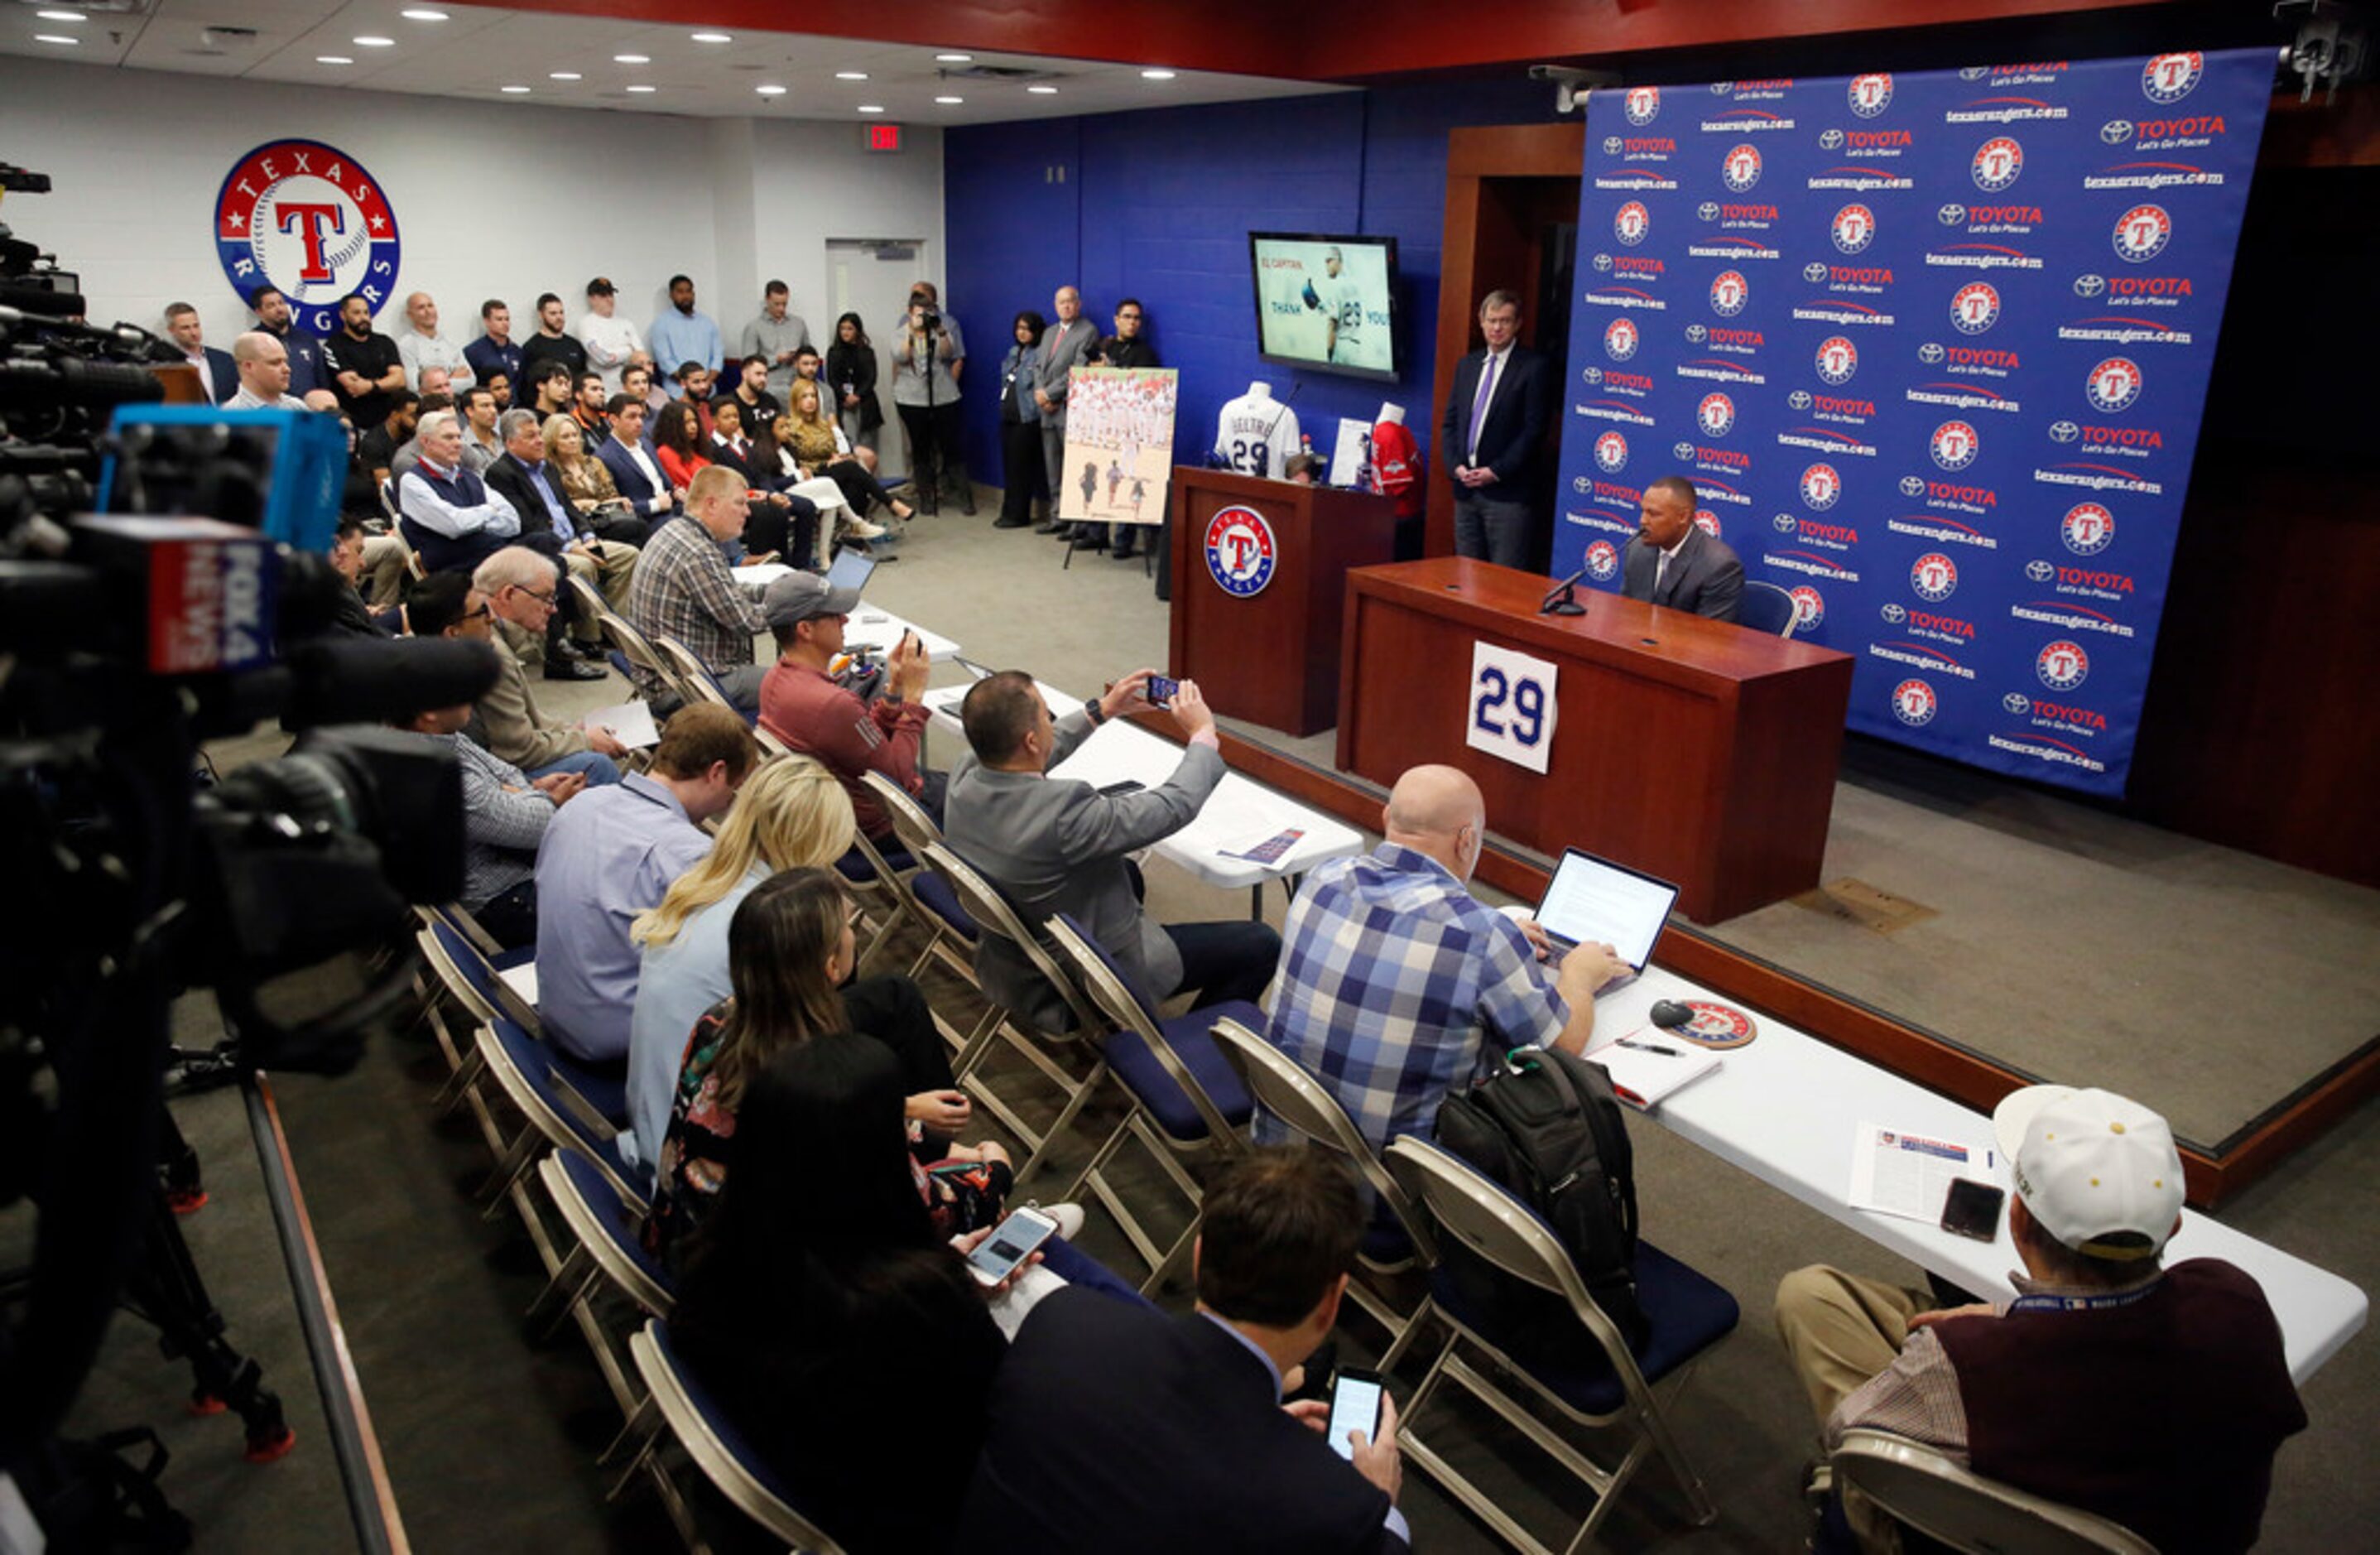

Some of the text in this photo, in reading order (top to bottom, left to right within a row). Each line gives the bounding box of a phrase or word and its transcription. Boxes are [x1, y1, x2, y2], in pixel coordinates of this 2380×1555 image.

[2137, 116, 2225, 137] TOYOTA
[872, 126, 897, 149] EXIT
[1623, 137, 1675, 152] TOYOTA
[1846, 130, 1911, 147] TOYOTA
[237, 152, 371, 204] TEXAS
[1722, 204, 1778, 219] TOYOTA
[1969, 205, 2042, 223] TOYOTA
[274, 202, 345, 285] T
[1614, 256, 1664, 272] TOYOTA
[1829, 266, 1892, 283] TOYOTA
[2108, 277, 2192, 294] TOYOTA
[1272, 301, 1301, 315] THANK
[1709, 328, 1763, 344] TOYOTA
[1947, 347, 2019, 367] TOYOTA
[1604, 370, 1652, 388] TOYOTA
[1814, 395, 1875, 414] TOYOTA
[2082, 426, 2161, 447] TOYOTA
[1233, 438, 1269, 477] 29
[1695, 447, 1749, 465] TOYOTA
[1928, 481, 1996, 506] TOYOTA
[1799, 519, 1858, 542] TOYOTA
[224, 545, 262, 626] FOX
[2058, 567, 2133, 591] TOYOTA
[1908, 610, 1974, 638] TOYOTA
[1476, 666, 1546, 747] 29
[2033, 700, 2106, 729] TOYOTA
